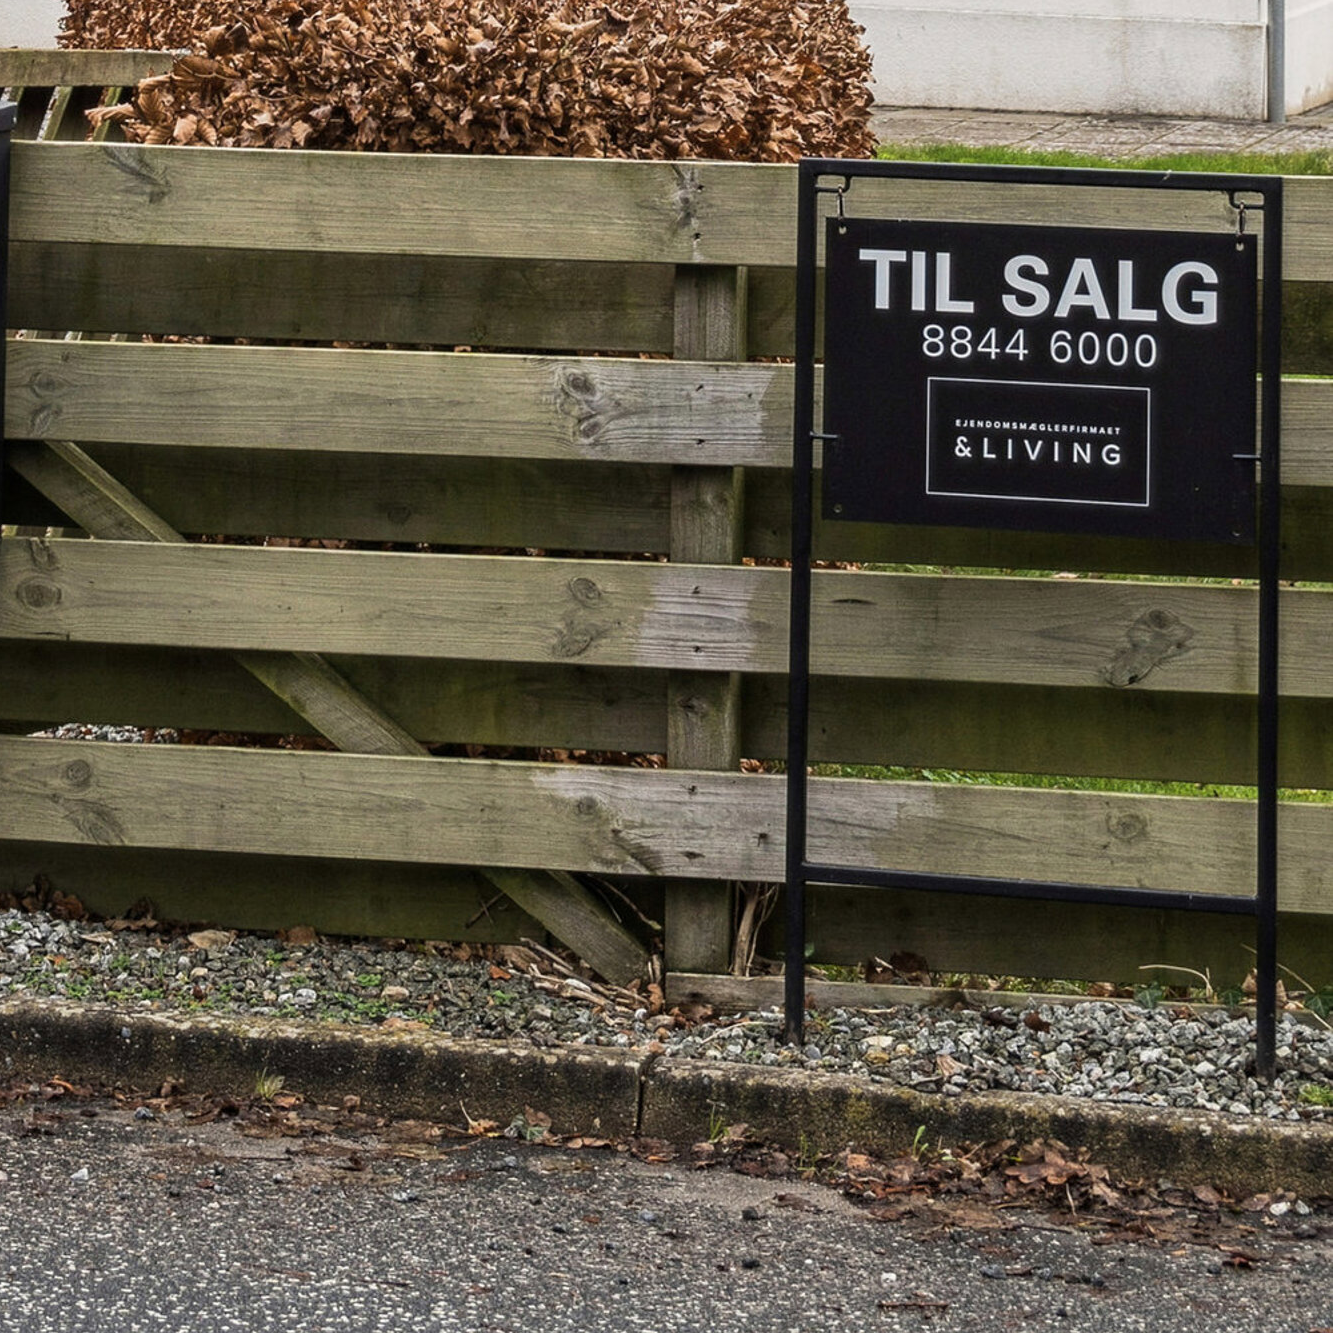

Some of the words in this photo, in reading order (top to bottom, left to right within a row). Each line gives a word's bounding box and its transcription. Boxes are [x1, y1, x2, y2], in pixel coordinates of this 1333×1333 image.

[858, 248, 975, 313] TIL
[1001, 254, 1219, 325] SALG
[922, 323, 1029, 361] 8844
[1049, 329, 1158, 368] 6000
[955, 418, 1121, 435] EJENDOMSMÆGLERFIRMAET
